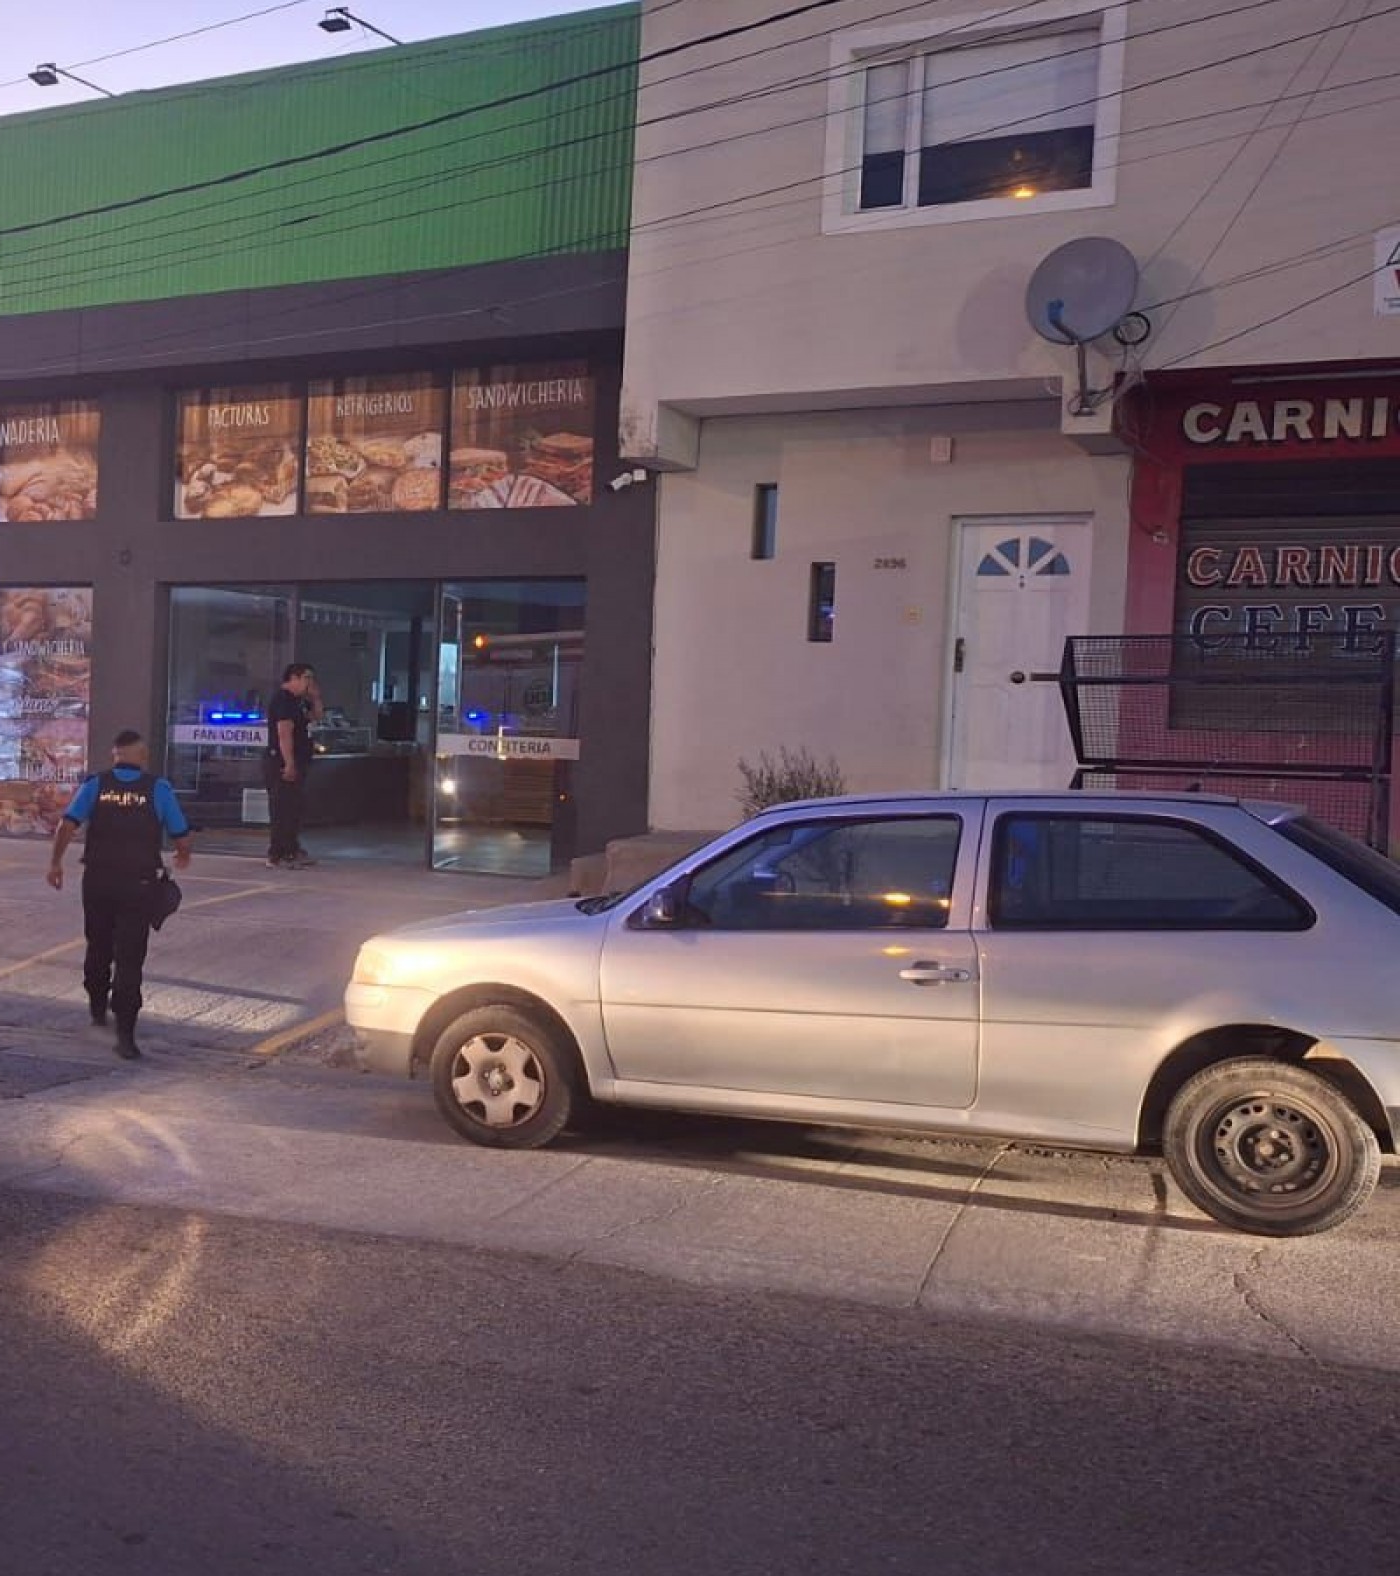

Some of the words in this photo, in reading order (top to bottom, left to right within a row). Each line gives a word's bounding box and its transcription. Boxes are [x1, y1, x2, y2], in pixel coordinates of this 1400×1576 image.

[335, 394, 414, 418] REFRIGERIOS
[466, 378, 584, 410] SANDWICHERIA
[206, 404, 270, 428] FACTURAS
[1182, 397, 1400, 444] CARNI
